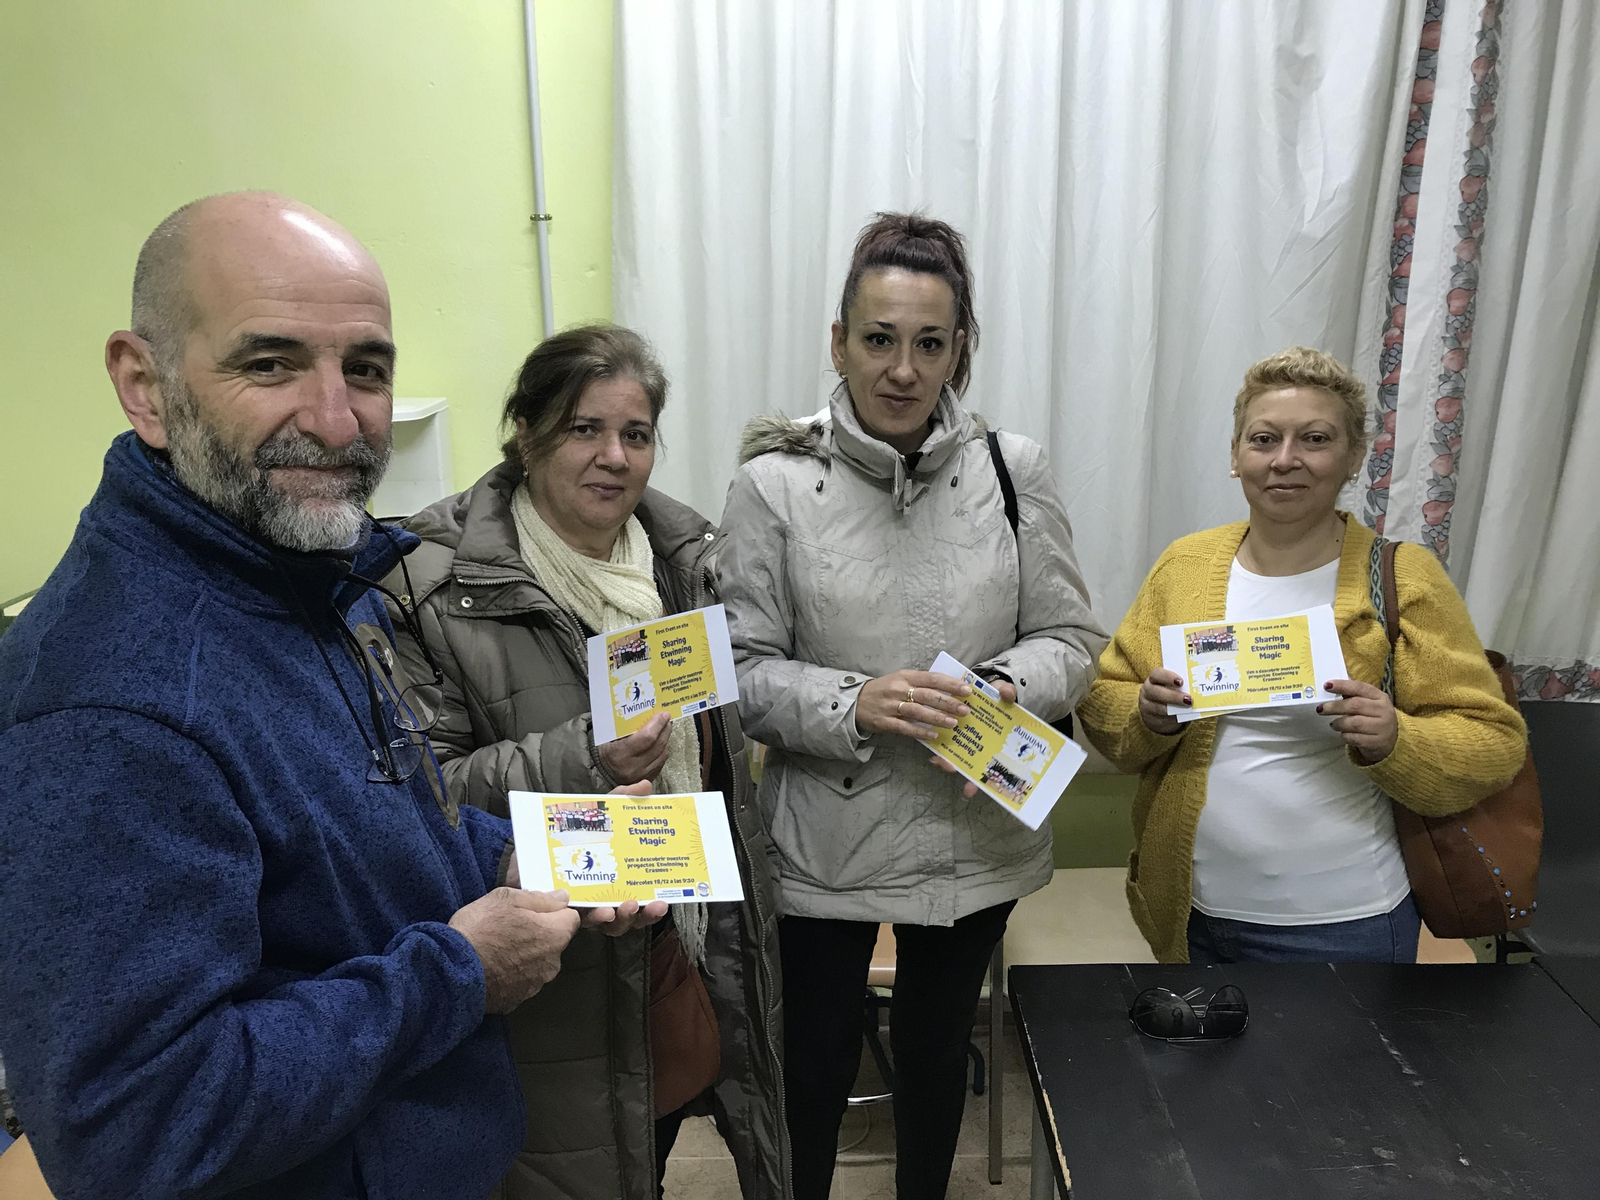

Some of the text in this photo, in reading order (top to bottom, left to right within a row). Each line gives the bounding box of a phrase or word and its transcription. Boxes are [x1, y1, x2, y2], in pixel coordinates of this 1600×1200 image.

[662, 637, 686, 648] Sharing
[1255, 635, 1284, 644] Sharing
[660, 646, 692, 659] Etwinning
[1251, 643, 1290, 652] Etwinning
[1259, 652, 1282, 660] Magic
[668, 656, 686, 667] Magic
[964, 724, 983, 741] Magic
[953, 726, 984, 752] Etwinning
[952, 735, 976, 757] Sharing
[953, 752, 965, 763] Event
[964, 760, 974, 770] First
[632, 817, 668, 826] Sharing
[628, 827, 675, 836] Etwinning
[639, 837, 666, 846] Magic
